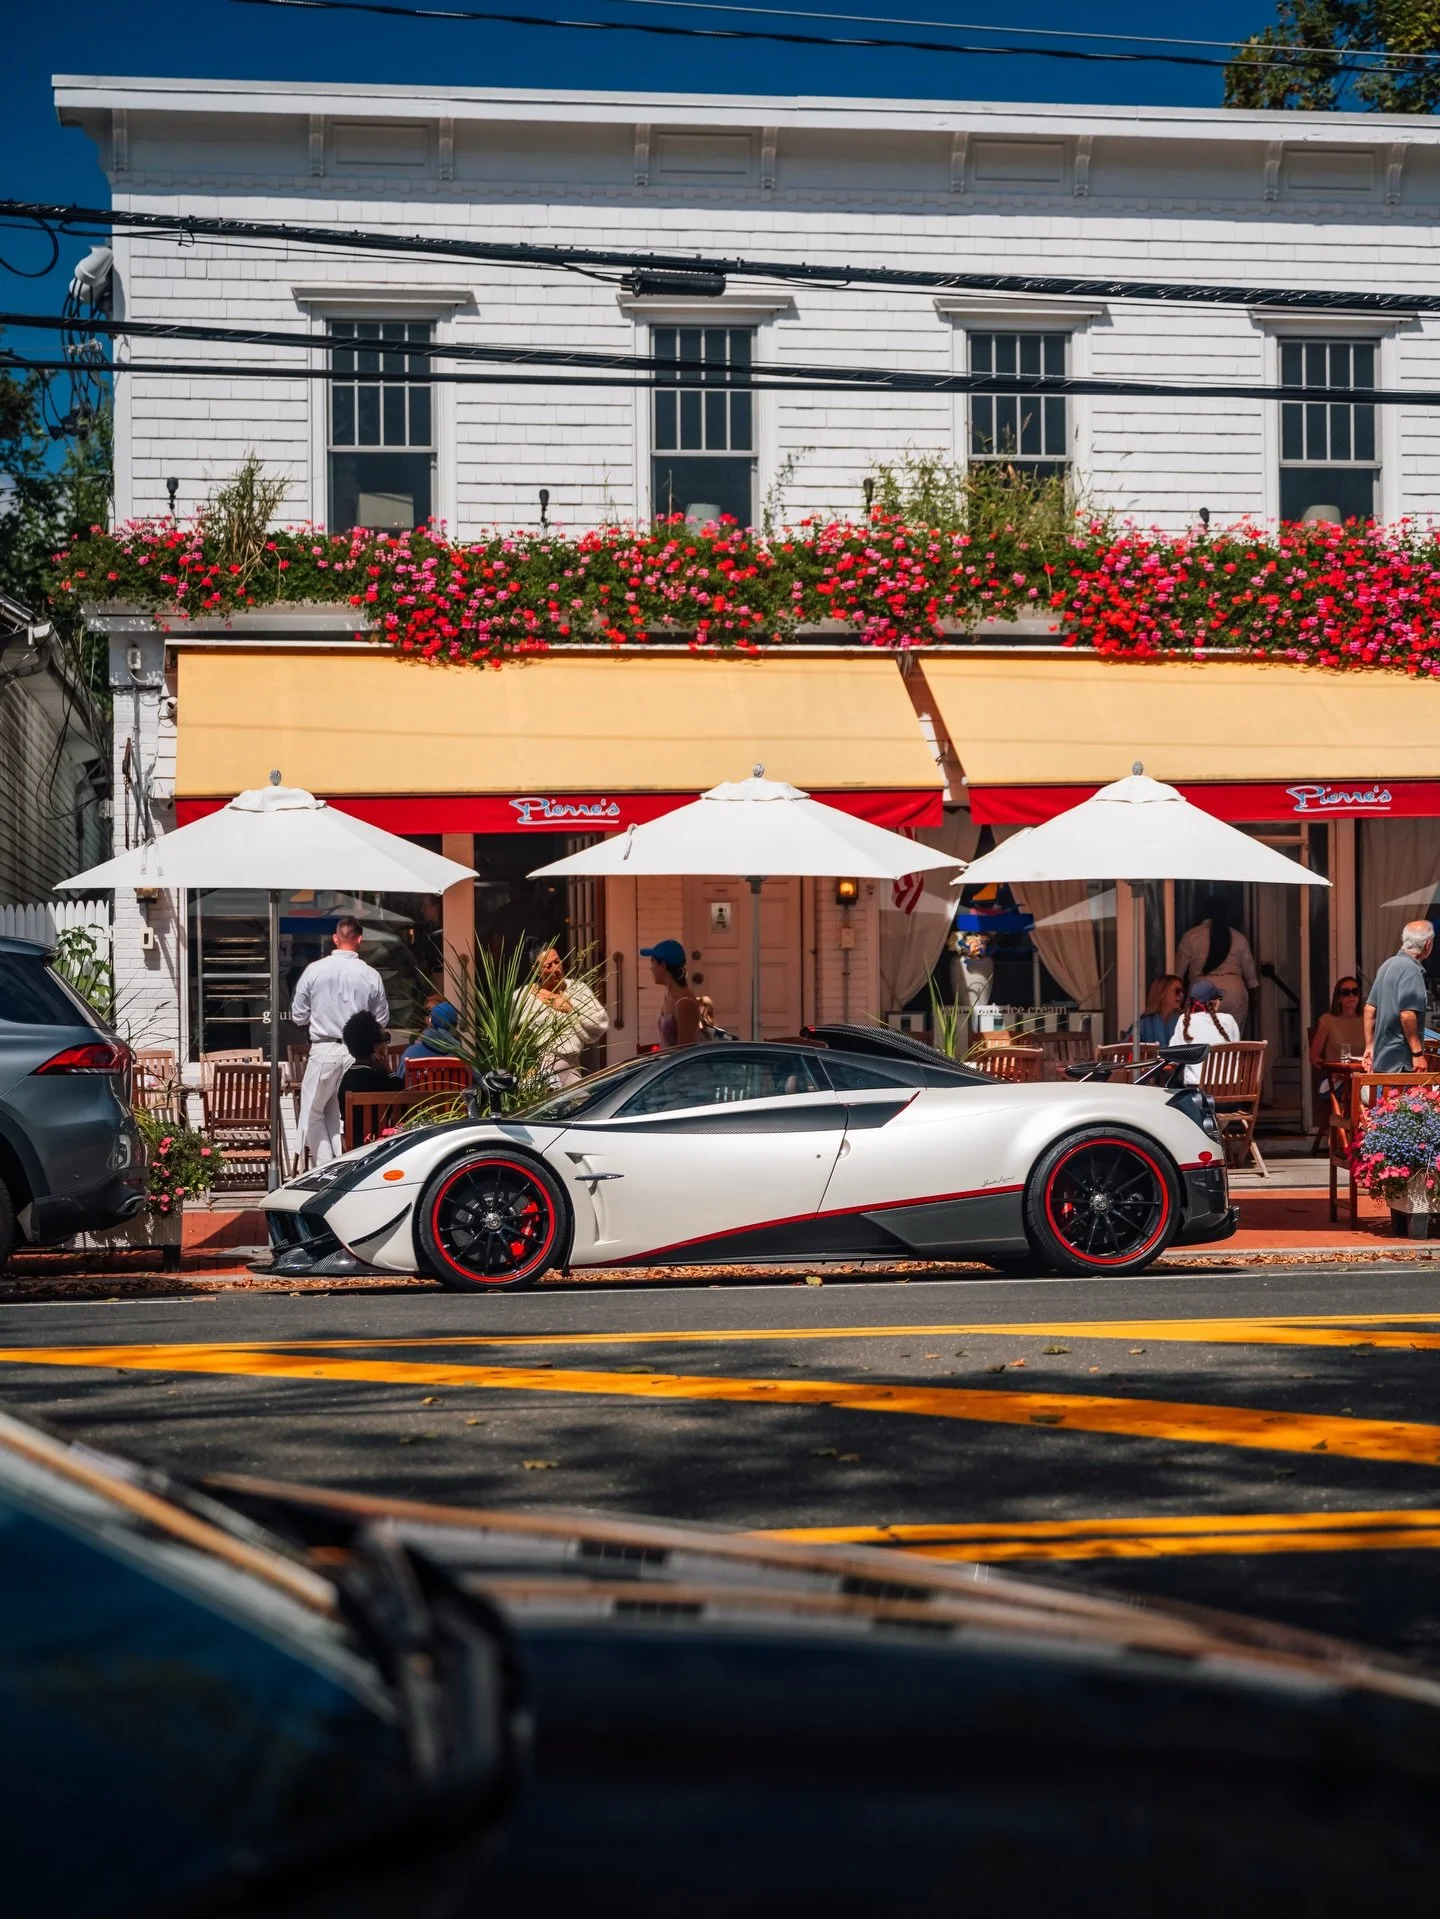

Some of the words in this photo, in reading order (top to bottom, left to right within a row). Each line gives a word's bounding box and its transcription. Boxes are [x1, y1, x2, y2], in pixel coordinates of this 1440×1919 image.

[508, 797, 621, 825] Pierre's
[1285, 785, 1393, 813] Pierre's
[1006, 1004, 1025, 1016] ice
[1027, 1006, 1067, 1016] cream
